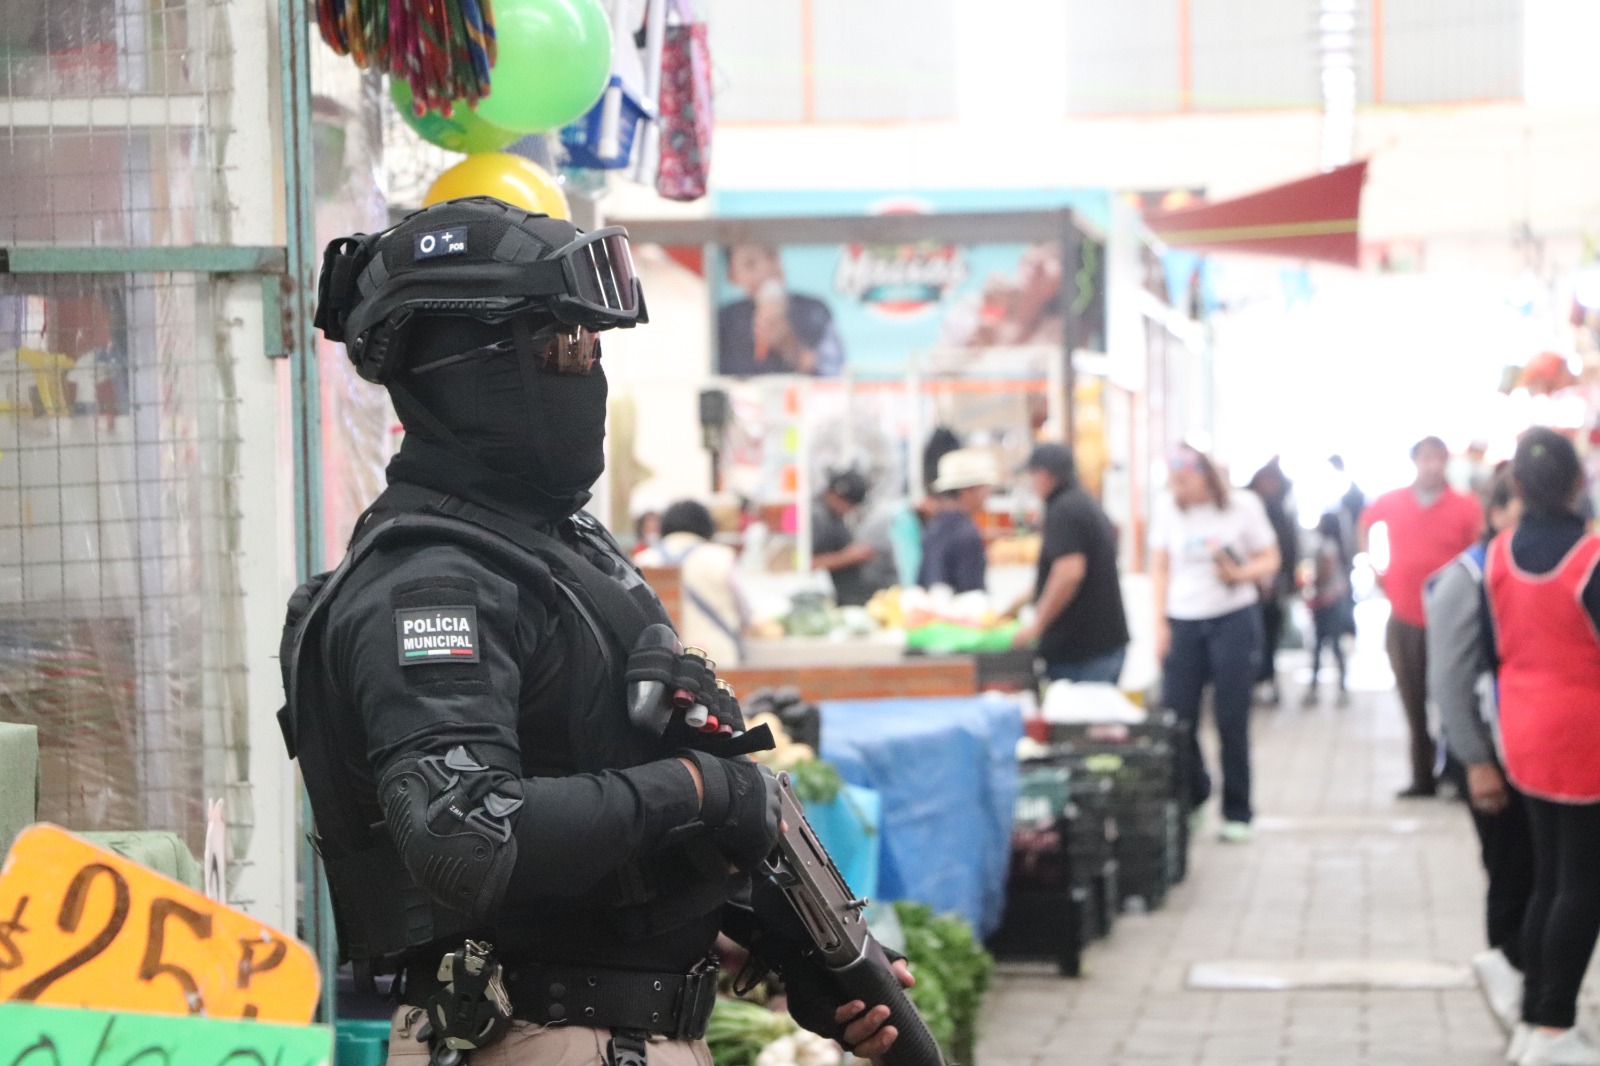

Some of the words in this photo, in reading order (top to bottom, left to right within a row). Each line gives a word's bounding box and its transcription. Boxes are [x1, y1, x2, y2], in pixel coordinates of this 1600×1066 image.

[448, 242, 465, 252] POS
[403, 613, 471, 634] POLÍCIA
[403, 635, 473, 650] MUNICIPAL
